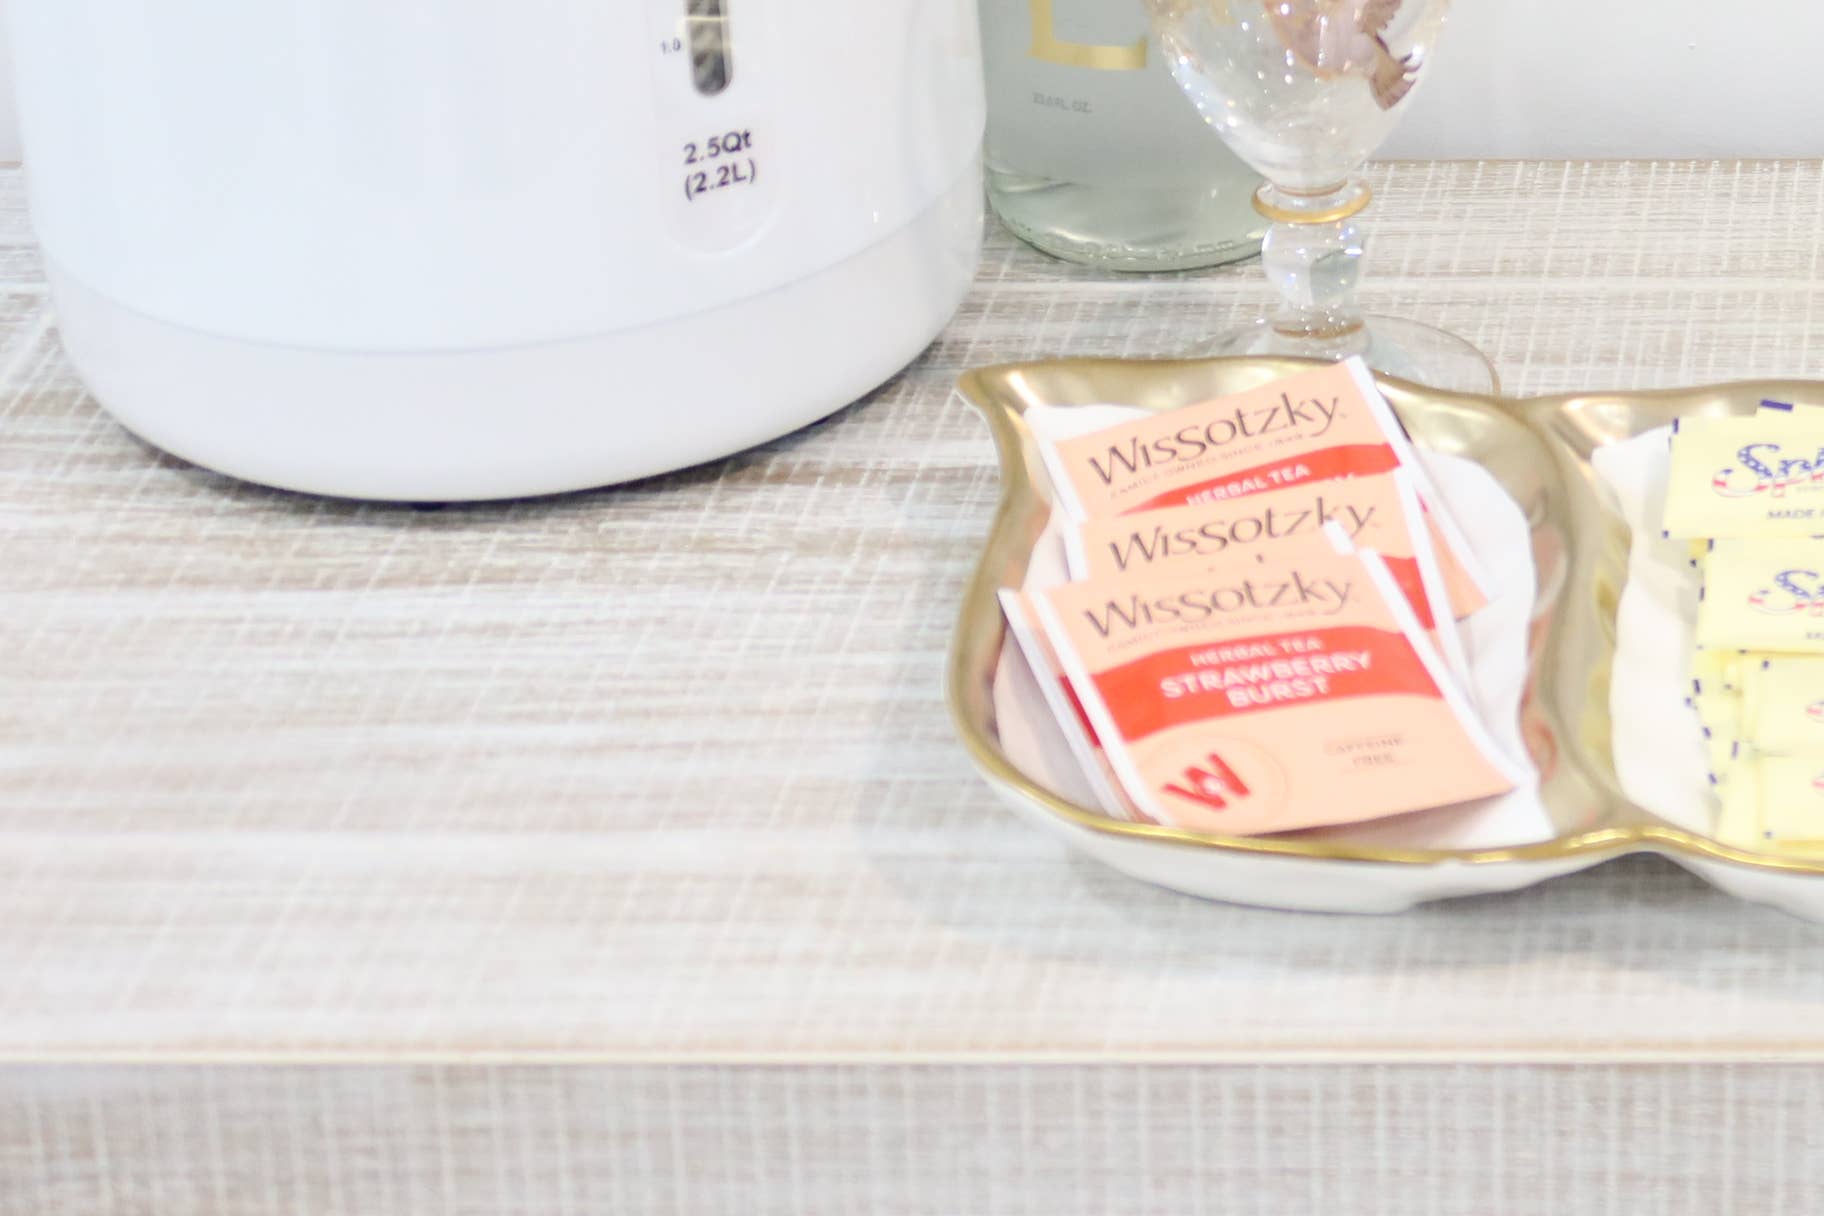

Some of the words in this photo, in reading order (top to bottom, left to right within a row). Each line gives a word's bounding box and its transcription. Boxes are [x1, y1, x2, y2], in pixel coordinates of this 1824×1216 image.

[683, 129, 753, 165] 2.5Qt
[683, 157, 756, 201] (2.2L)
[1185, 475, 1268, 507] HERBAL
[1266, 464, 1312, 488] TEA
[1766, 508, 1816, 520] MADE
[1190, 643, 1277, 667] HERBAL
[1278, 637, 1323, 654] TEA
[1160, 650, 1371, 698] STRAWBERRY
[1226, 676, 1330, 708] BURST
